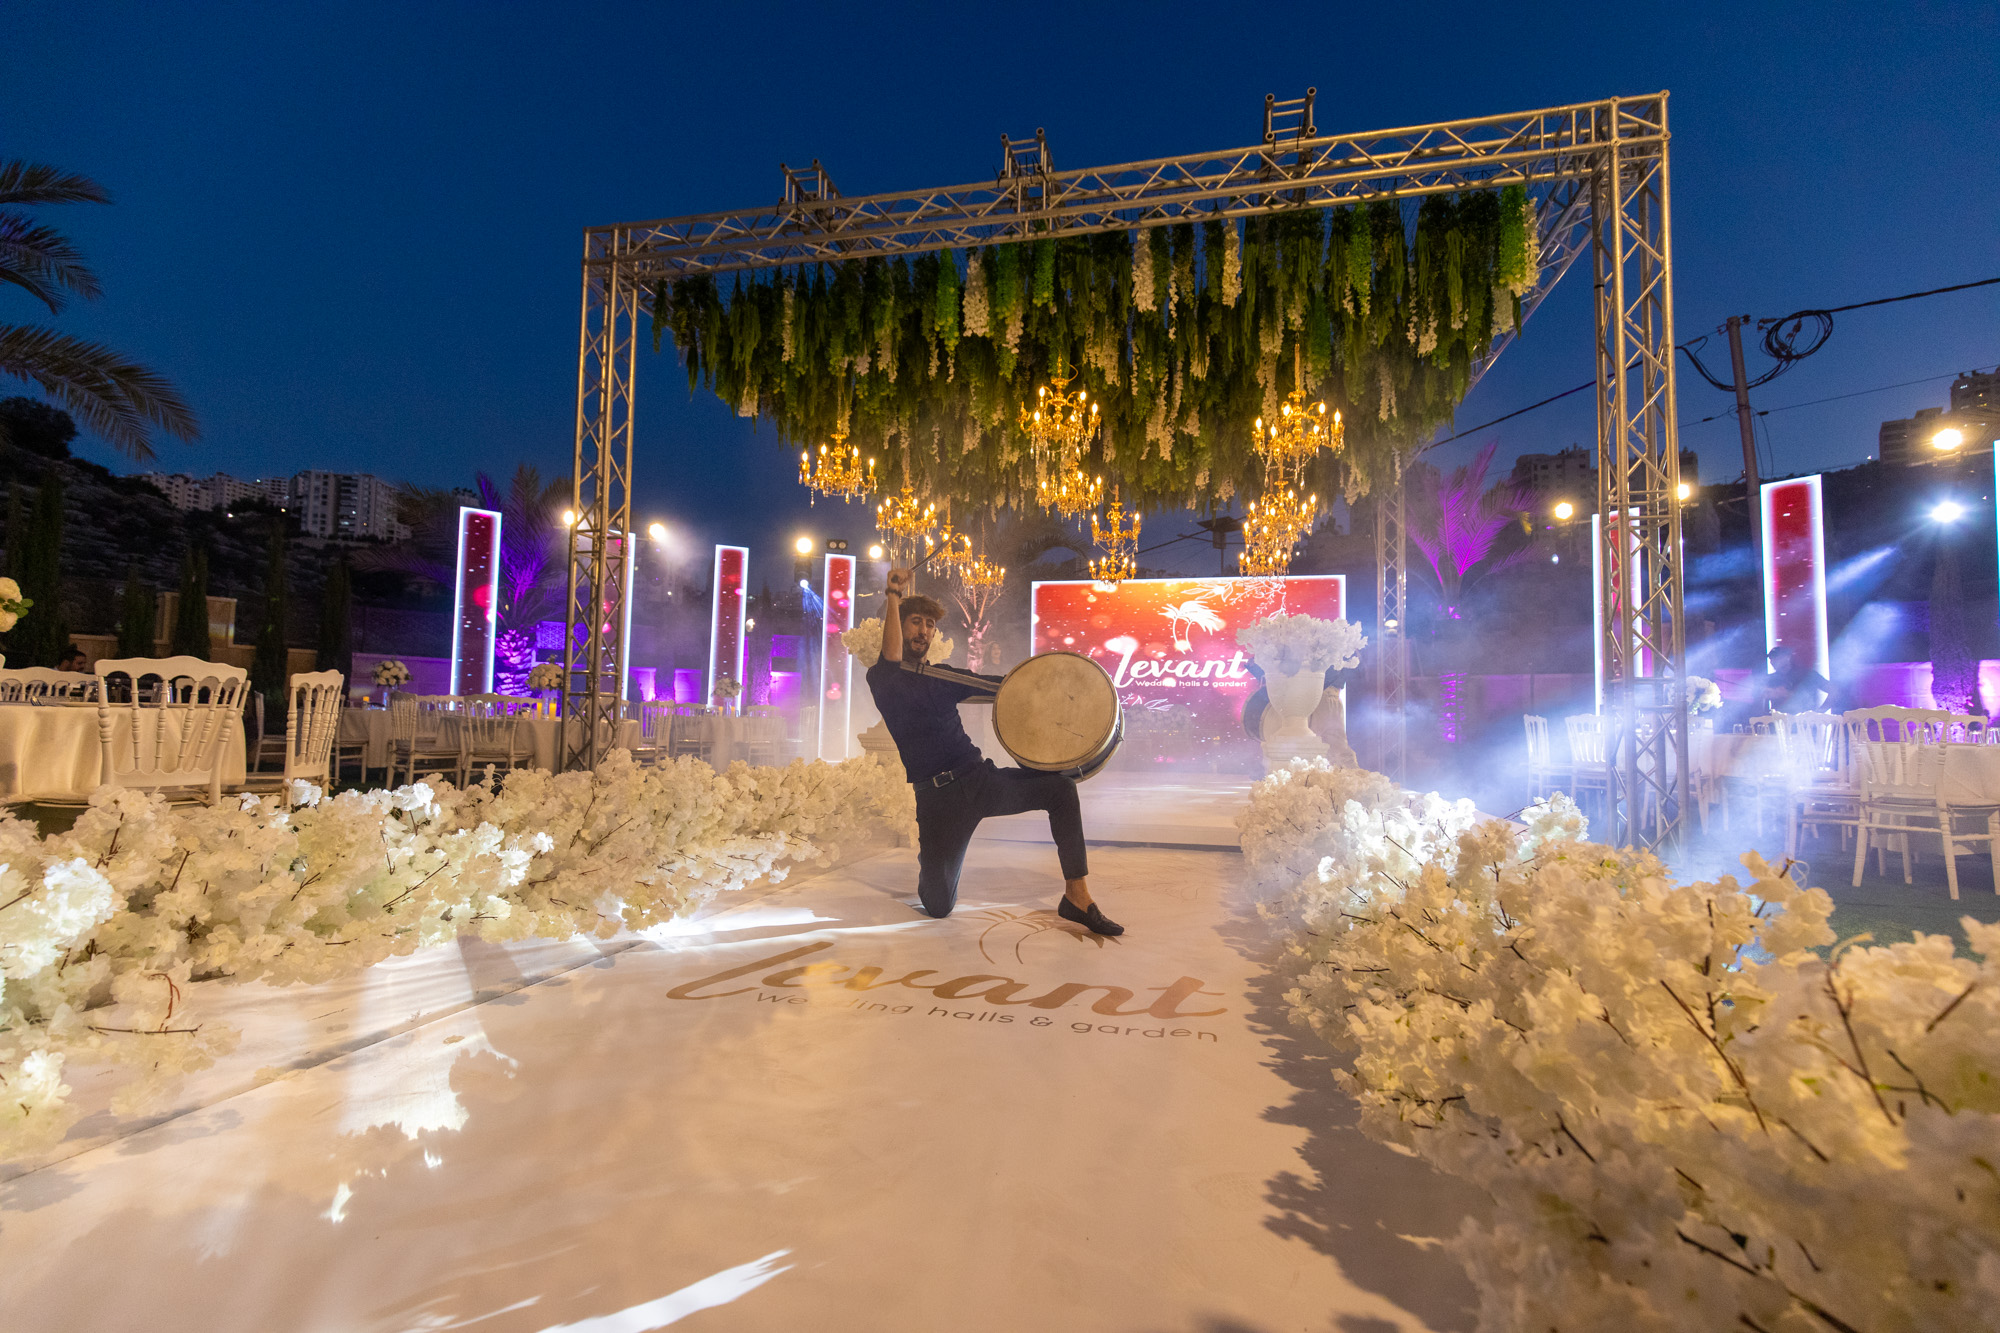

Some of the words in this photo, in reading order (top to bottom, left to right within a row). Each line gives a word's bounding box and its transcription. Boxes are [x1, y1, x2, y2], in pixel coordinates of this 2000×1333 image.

[757, 992, 914, 1015] Weing
[927, 1006, 1015, 1024] halls
[1029, 1016, 1054, 1027] &
[1070, 1022, 1218, 1043] garden
